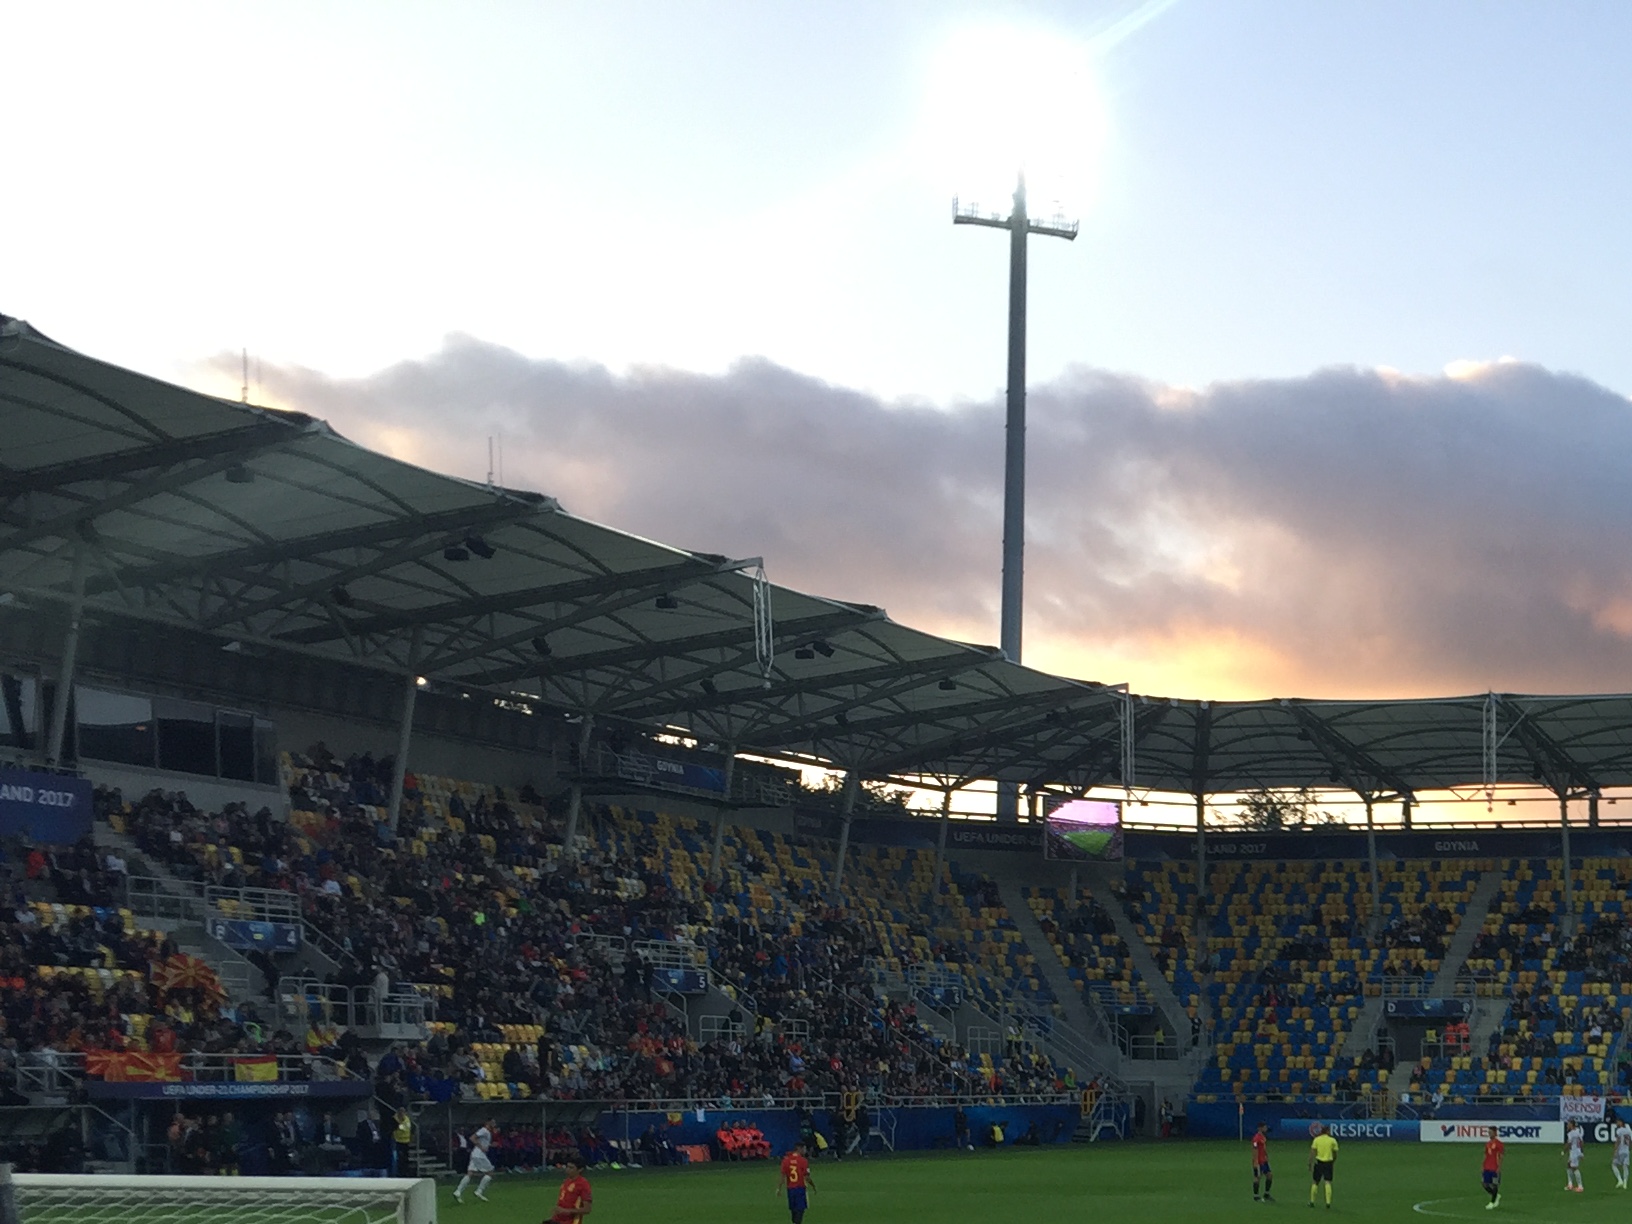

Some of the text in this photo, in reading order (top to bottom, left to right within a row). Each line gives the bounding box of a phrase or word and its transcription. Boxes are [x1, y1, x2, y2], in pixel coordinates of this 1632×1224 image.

[38, 790, 74, 807] 2017
[1435, 841, 1479, 852] GDYNIA
[699, 976, 706, 989] 5
[1387, 1002, 1396, 1013] D
[1330, 1123, 1393, 1137] RESPECT
[1457, 1125, 1541, 1138] INTESPORT
[789, 1164, 798, 1182] 3
